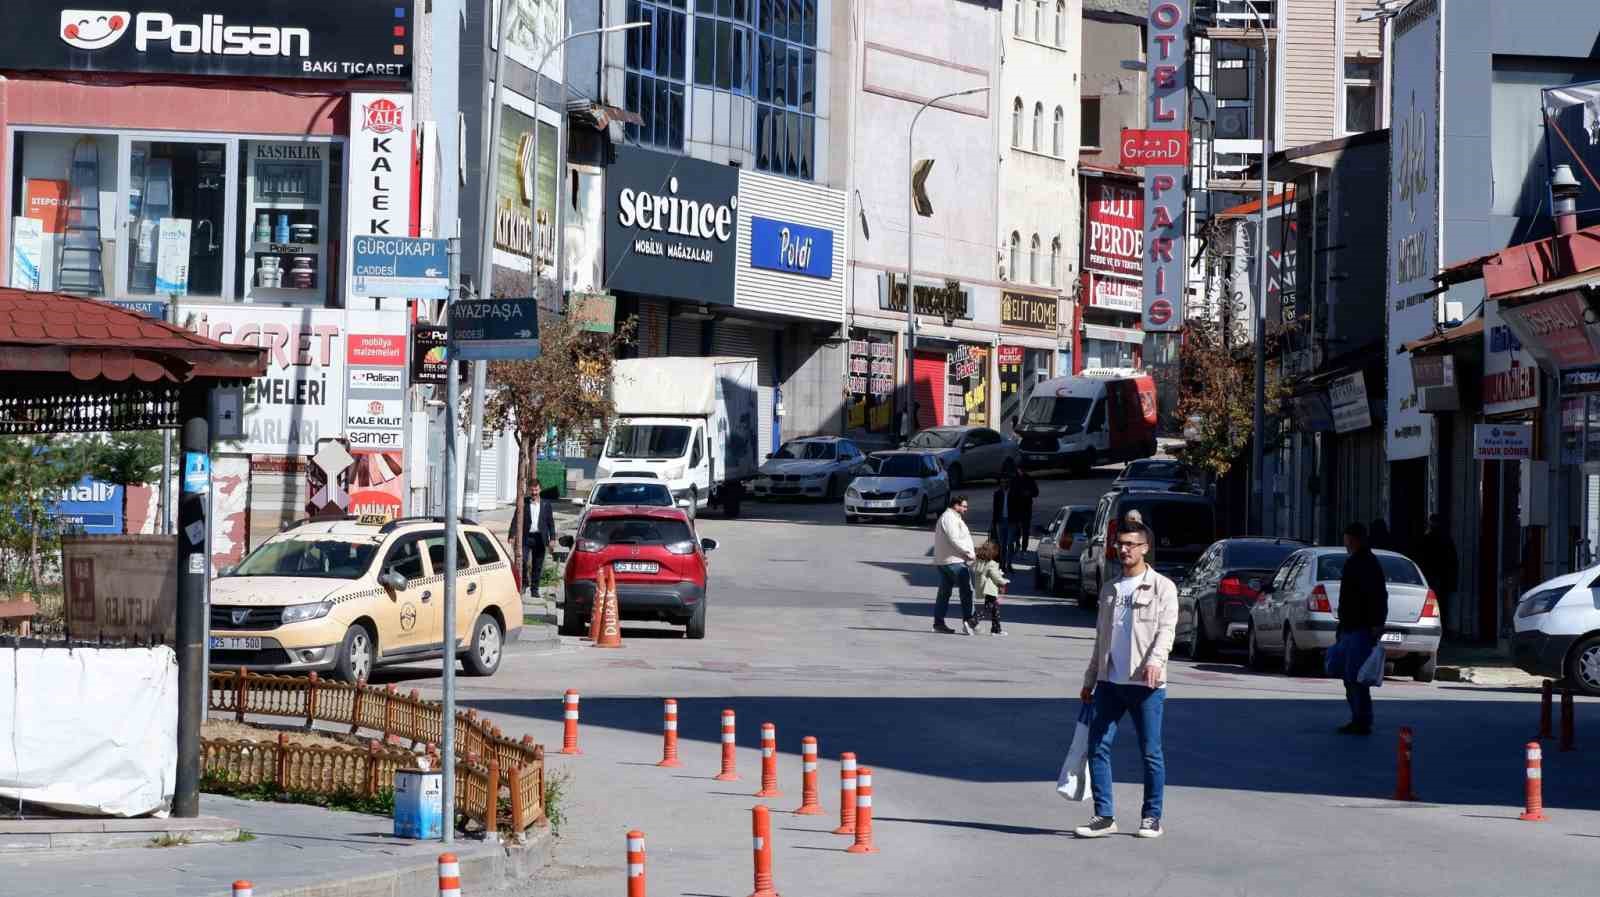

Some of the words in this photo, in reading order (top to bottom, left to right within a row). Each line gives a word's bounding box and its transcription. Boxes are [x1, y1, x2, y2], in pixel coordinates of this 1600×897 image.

[136, 12, 310, 57] Polisan
[619, 177, 732, 242] serince
[356, 238, 436, 257] GÜRCÜKAPI
[455, 303, 524, 321] AYAZPAŞA
[1030, 302, 1056, 325] HOME
[366, 373, 399, 382] Polisan
[348, 417, 376, 425] KALE
